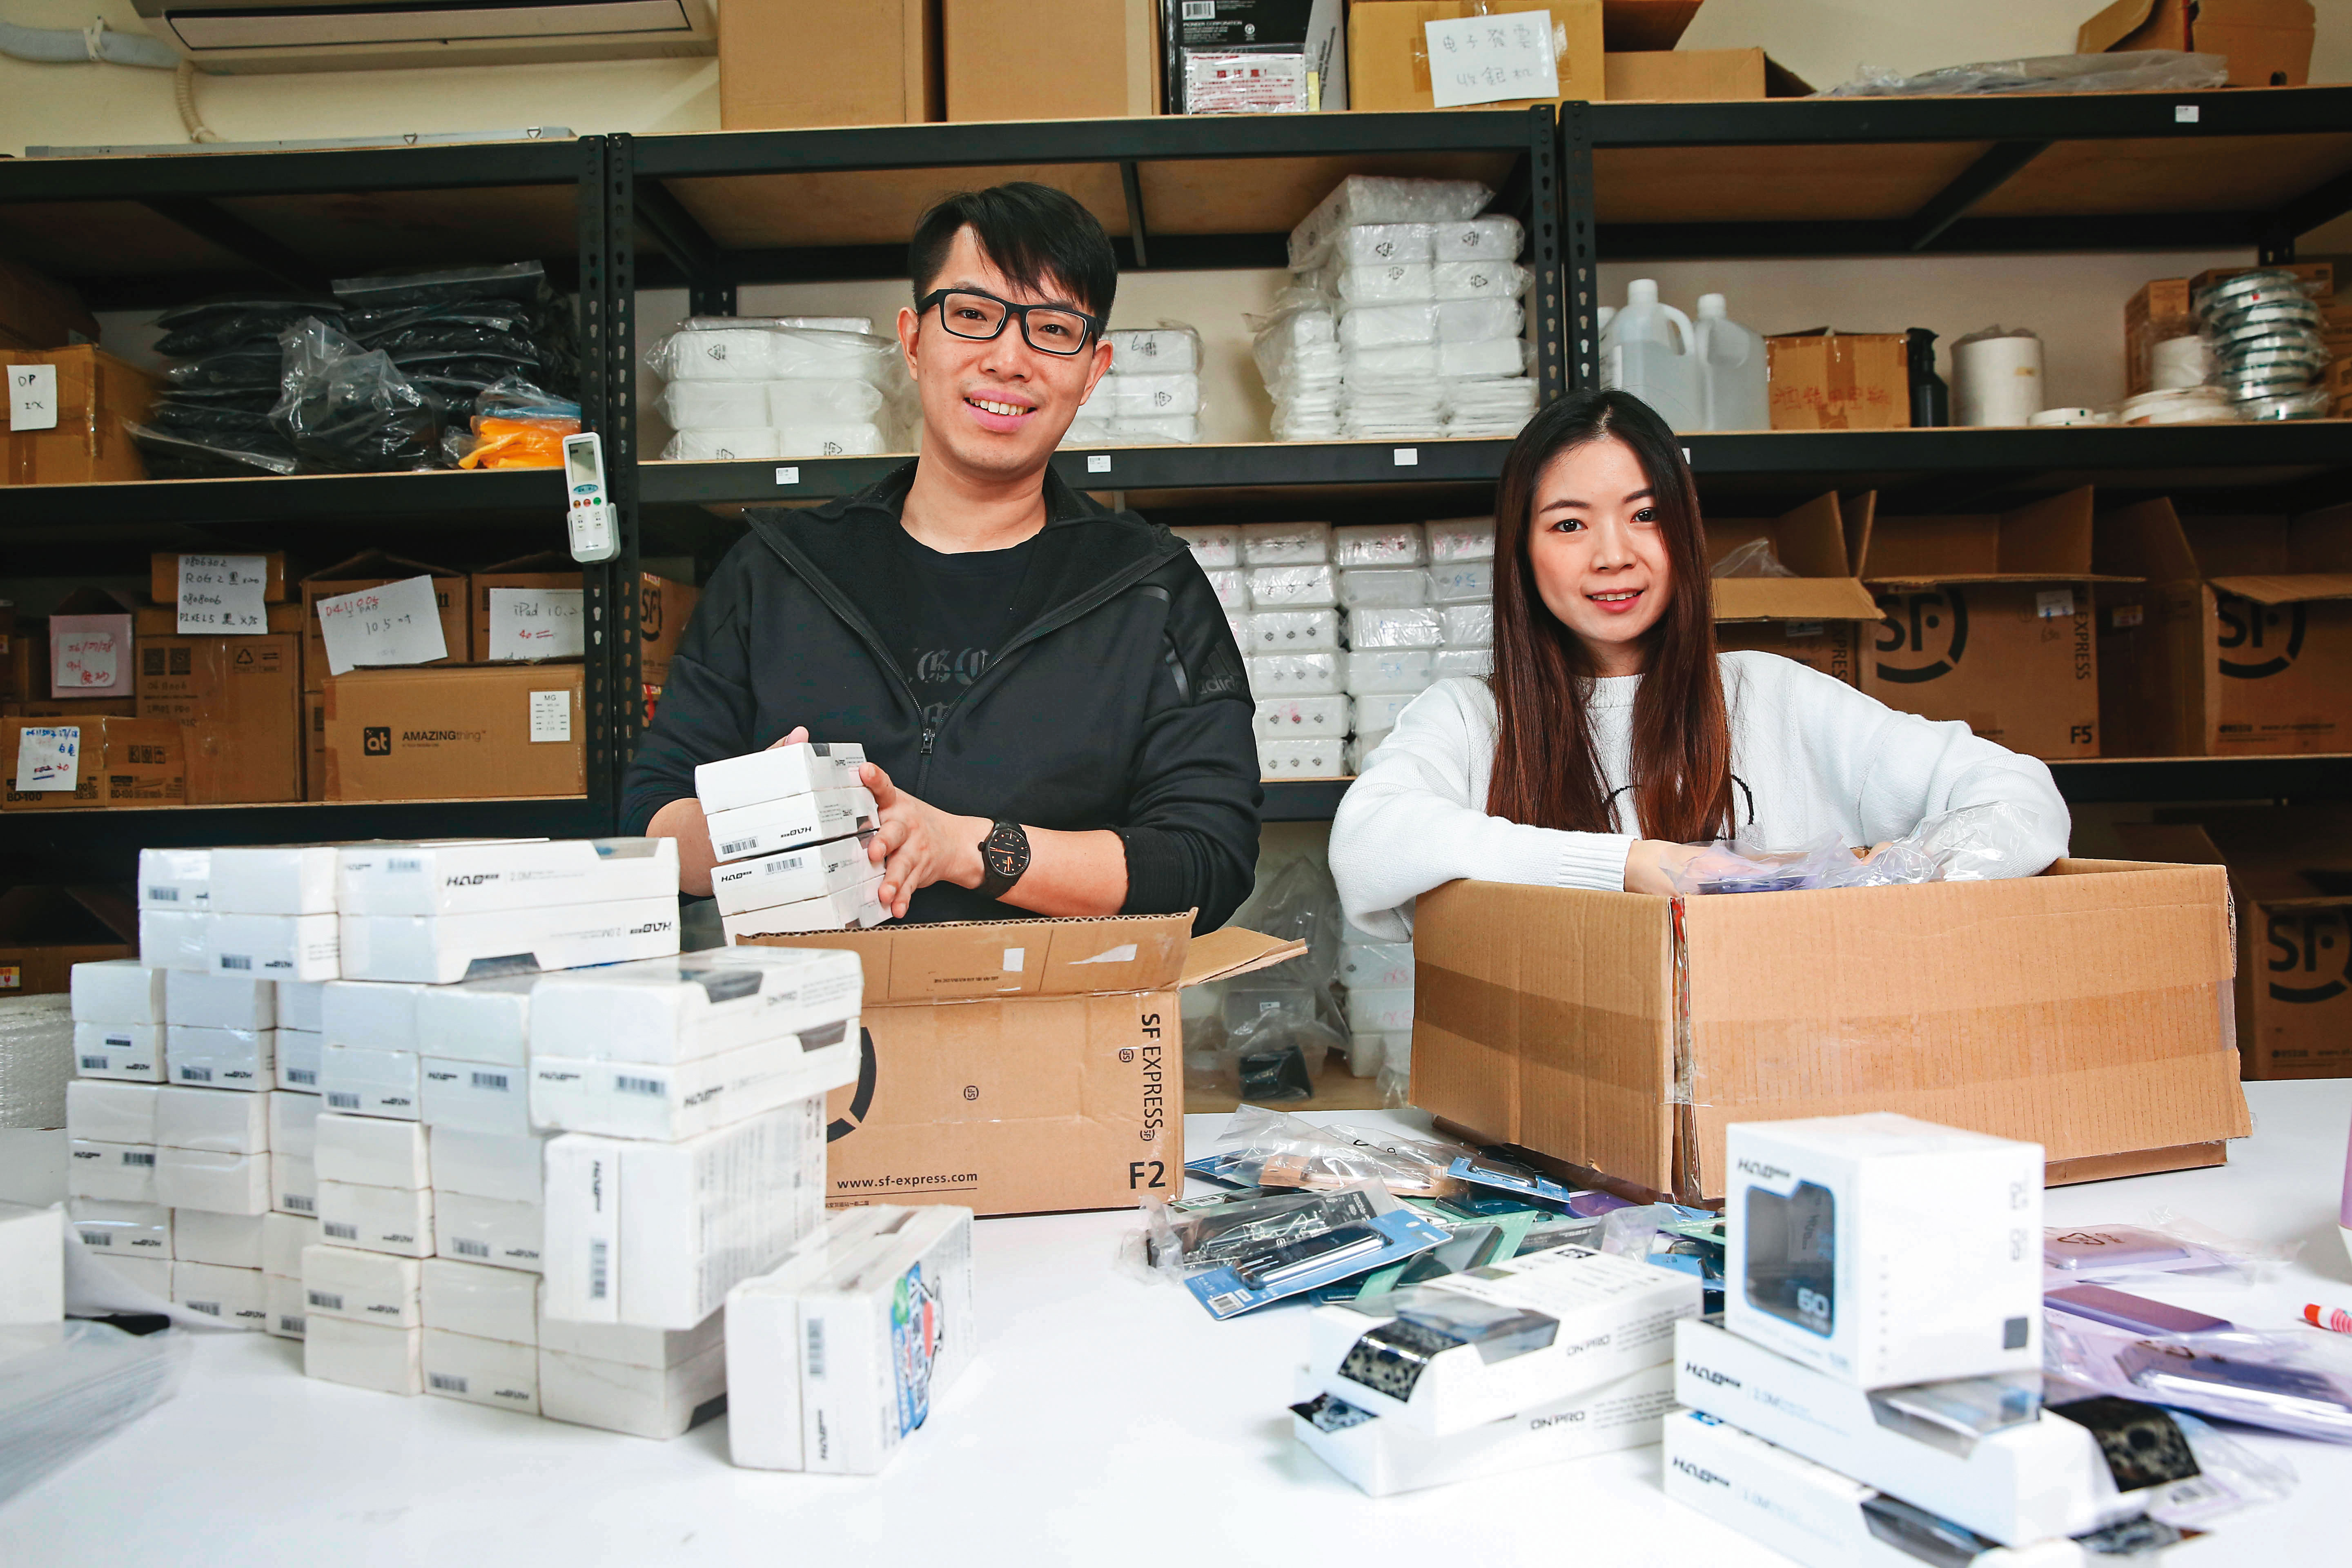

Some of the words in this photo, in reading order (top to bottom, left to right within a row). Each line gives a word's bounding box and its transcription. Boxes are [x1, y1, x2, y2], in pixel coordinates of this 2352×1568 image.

[514, 602, 538, 617] iPad
[2075, 612, 2091, 680] EXPRESS
[367, 733, 388, 751] at
[2070, 726, 2092, 744] F5
[2268, 914, 2339, 972] SF
[1142, 1013, 1160, 1038] SF
[1143, 1046, 1163, 1129] EXPRESS
[837, 1173, 978, 1188] www.sf-express.com
[1129, 1160, 1166, 1189] F2
